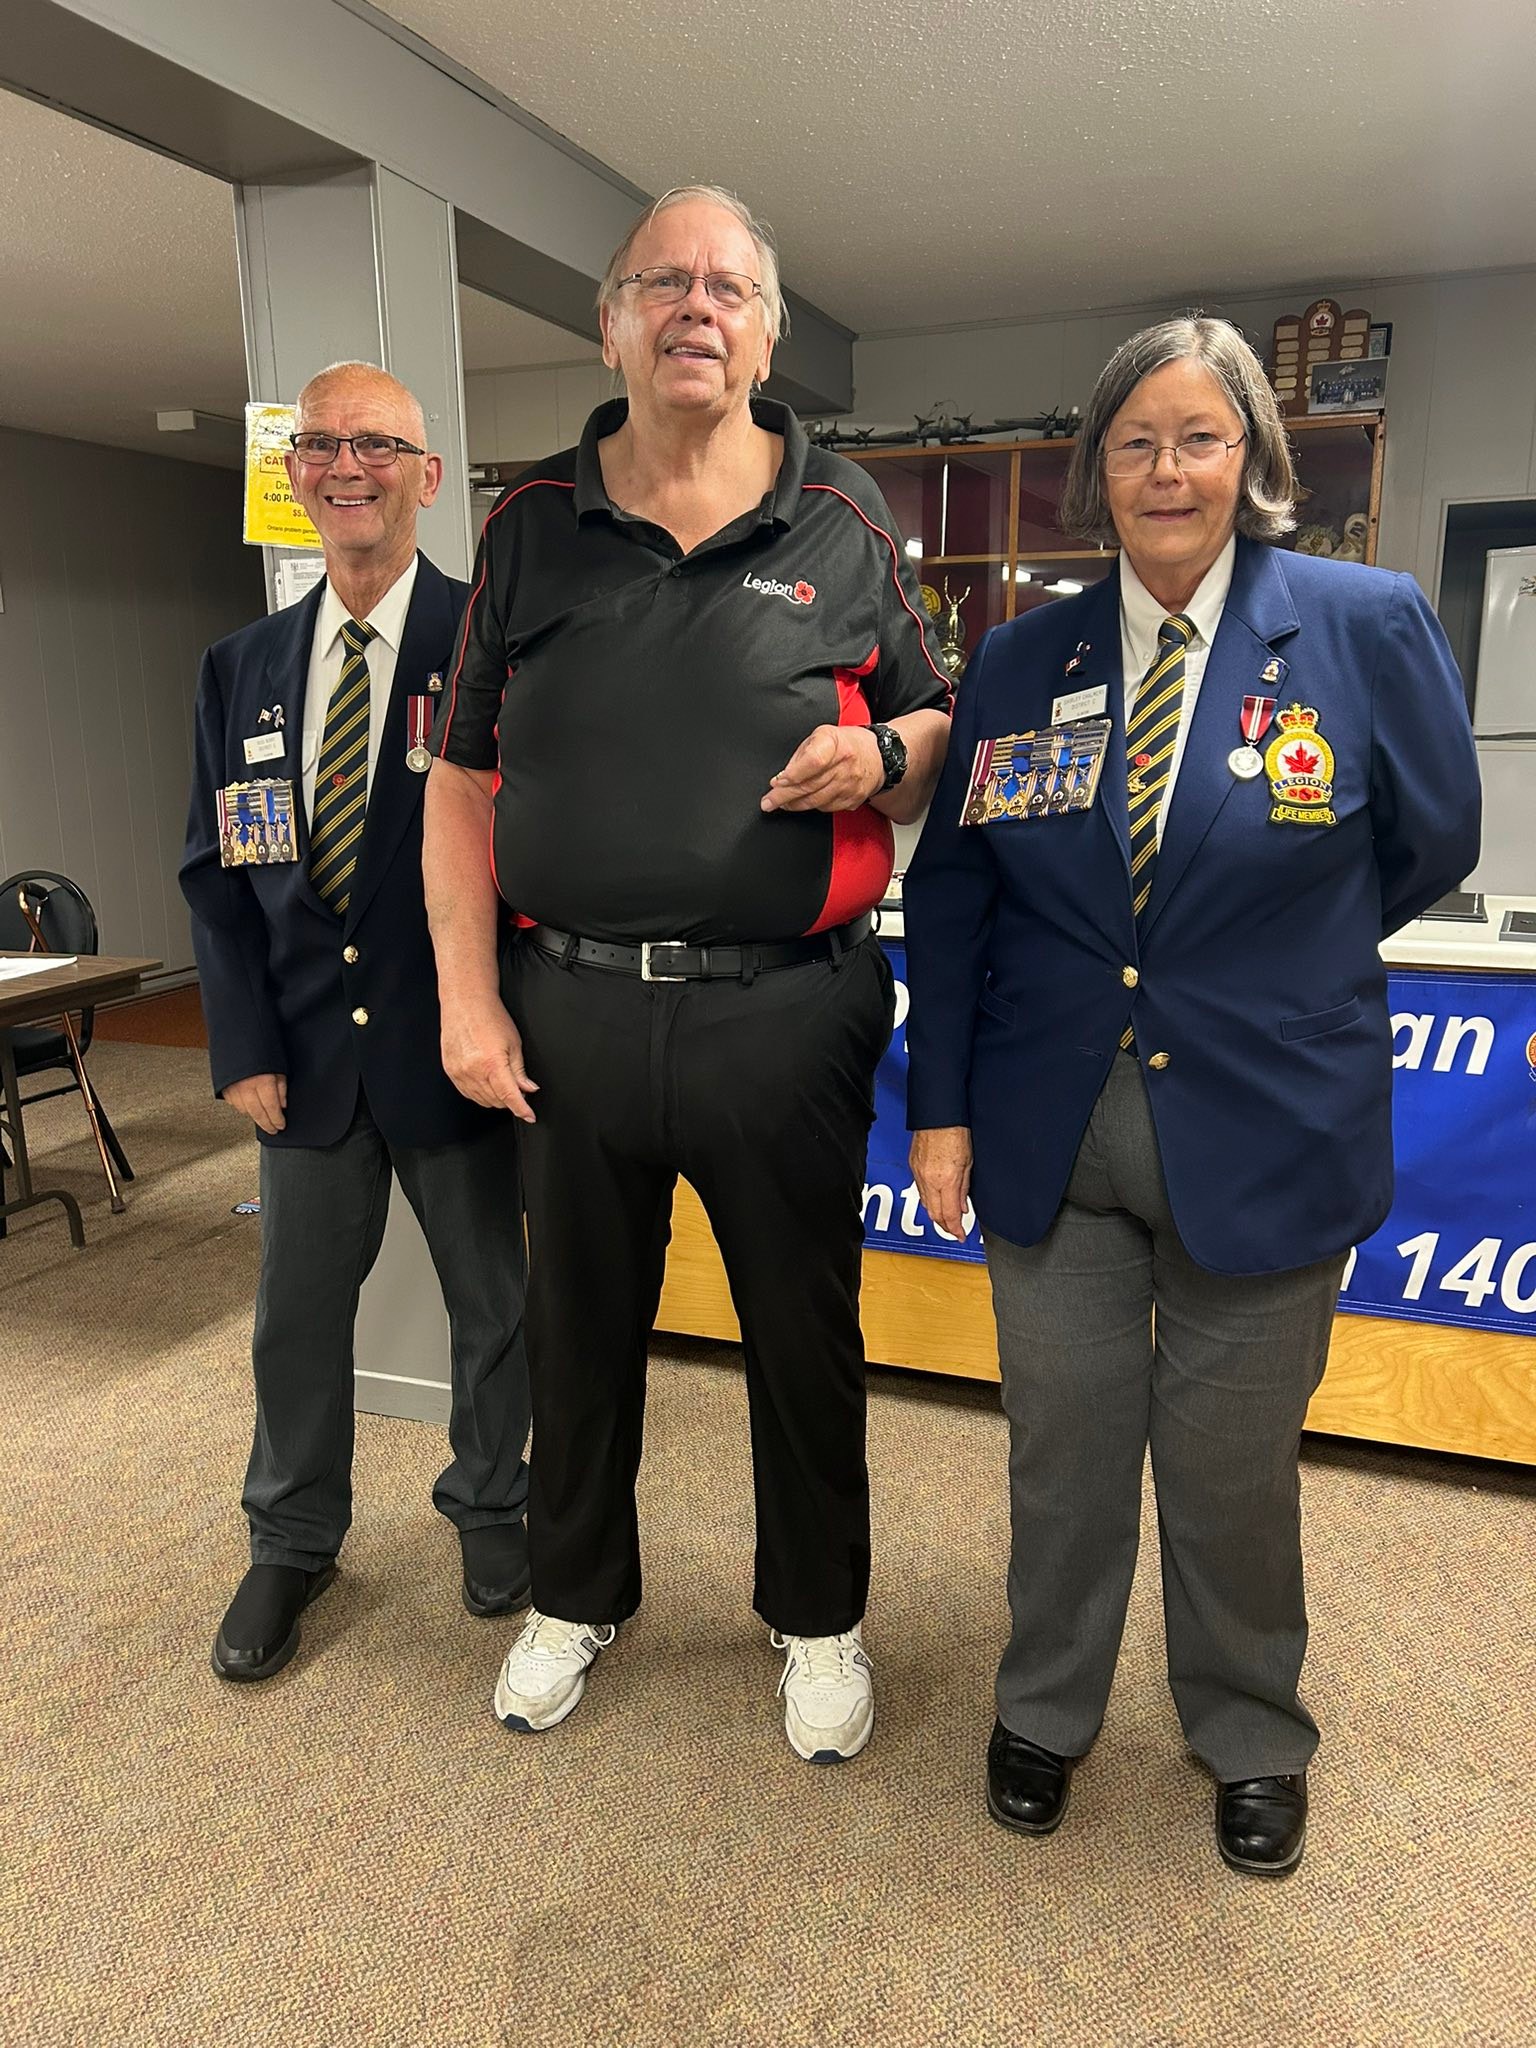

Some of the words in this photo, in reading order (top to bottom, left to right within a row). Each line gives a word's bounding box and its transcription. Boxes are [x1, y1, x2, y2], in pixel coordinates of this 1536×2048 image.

[263, 492, 281, 502] 4:00
[742, 571, 794, 596] Legion
[1279, 777, 1328, 792] LEGION
[1282, 806, 1298, 819] LIFE
[1298, 808, 1330, 820] MEMBER
[1396, 1231, 1536, 1314] 140
